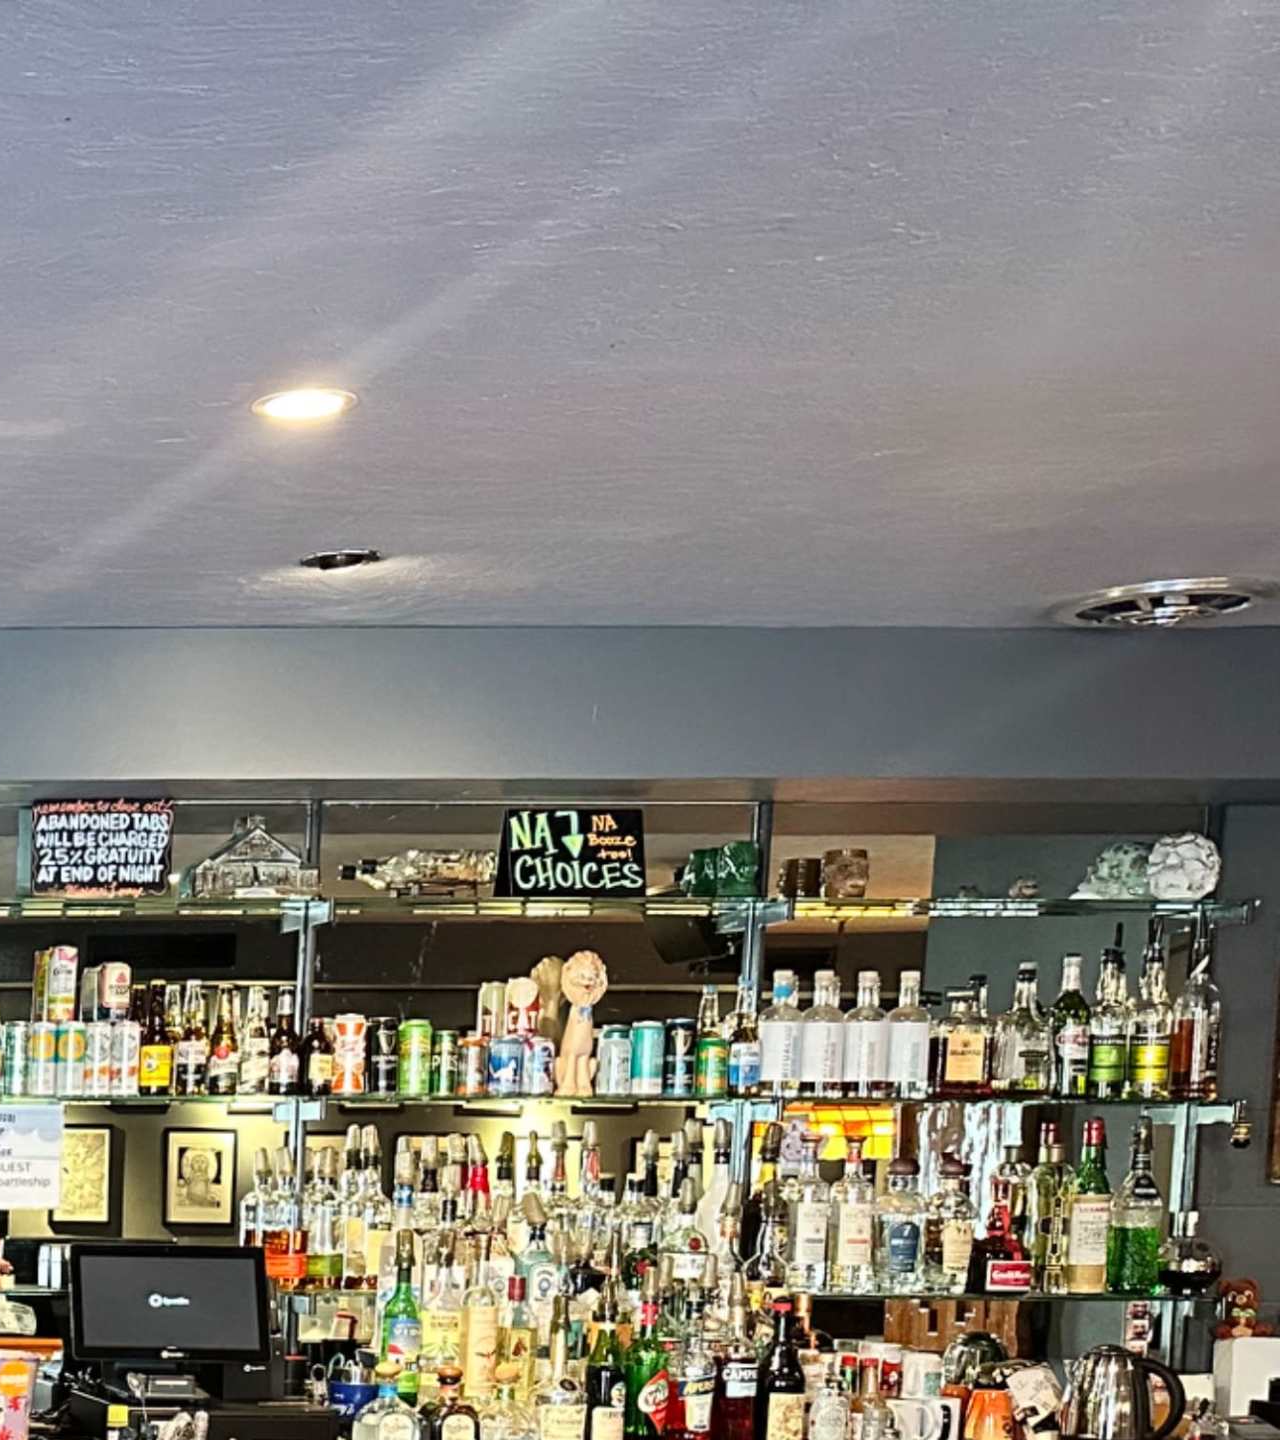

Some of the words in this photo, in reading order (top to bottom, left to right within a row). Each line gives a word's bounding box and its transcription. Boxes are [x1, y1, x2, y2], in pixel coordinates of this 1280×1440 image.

[36, 813, 130, 831] ABANDONED
[131, 813, 169, 831] TABS
[592, 813, 618, 832] NA
[36, 831, 72, 849] WILL
[73, 832, 96, 847] BE
[98, 831, 169, 849] CHARGED
[509, 811, 559, 855] NA
[40, 849, 81, 865] 25%
[84, 848, 163, 865] GRATUITY
[37, 866, 59, 883] AT
[60, 866, 93, 882] END
[96, 866, 116, 882] OF
[117, 865, 164, 883] NIGHT
[514, 854, 644, 890] CHOICES
